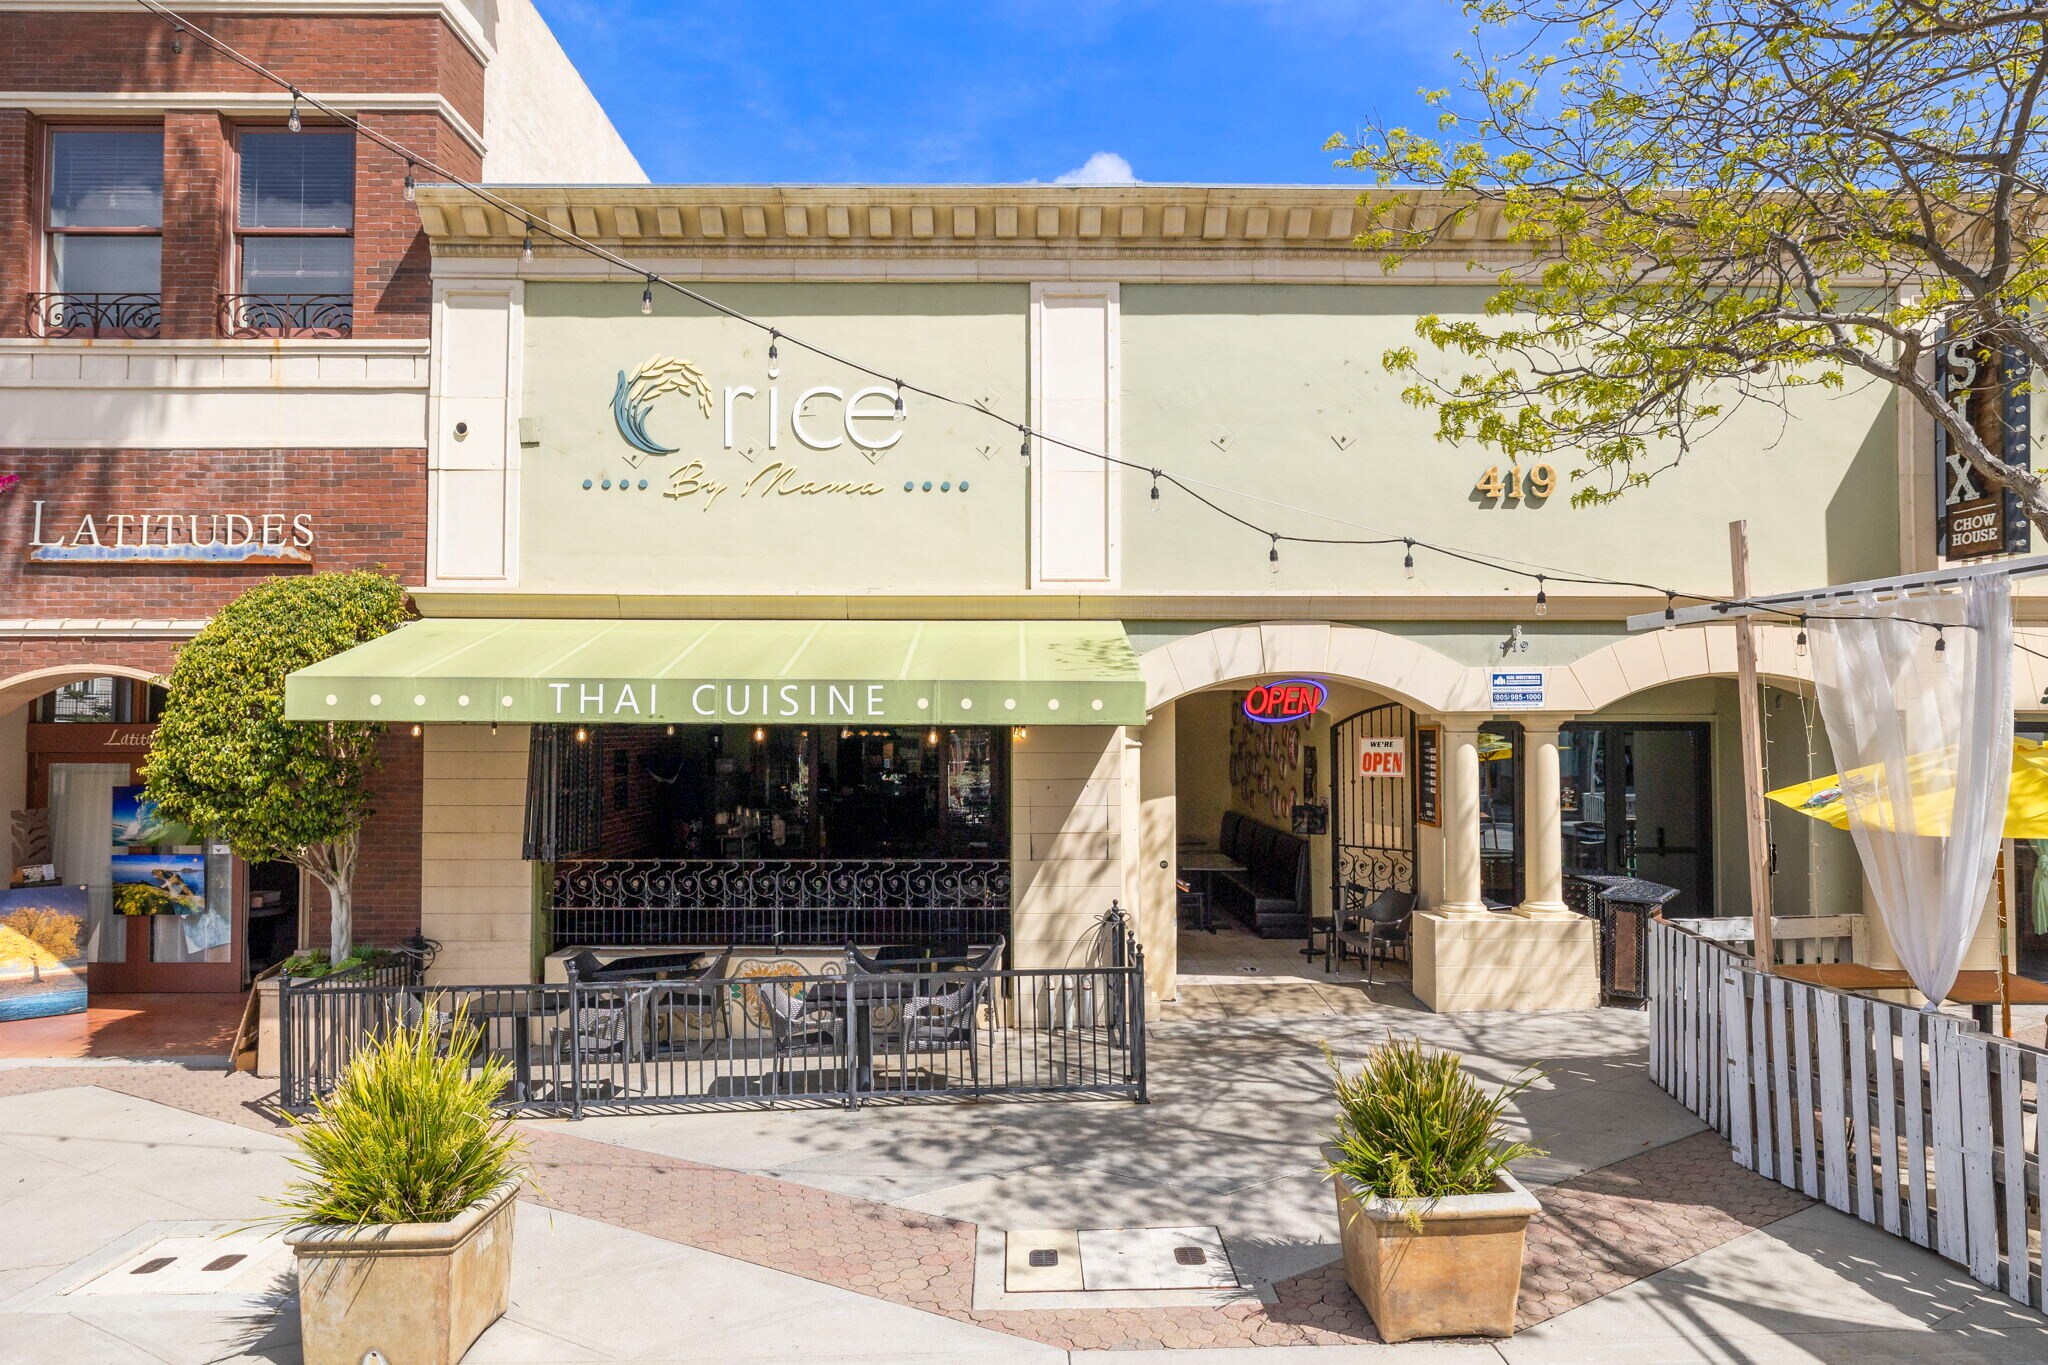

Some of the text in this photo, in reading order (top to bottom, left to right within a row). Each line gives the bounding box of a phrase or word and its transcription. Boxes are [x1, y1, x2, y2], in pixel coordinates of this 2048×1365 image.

[724, 368, 907, 449] rice
[663, 459, 885, 512] By Mama
[1476, 463, 1557, 499] 419
[29, 500, 314, 547] LATITUDES
[1953, 513, 1997, 532] CHOW
[1952, 528, 1999, 547] HOUSE
[549, 683, 885, 716] THAI CUISINE
[1245, 686, 1320, 715] OPEN
[1510, 693, 1542, 701] 985-1000
[103, 729, 159, 746] Latitu
[1362, 752, 1402, 773] OPEN
